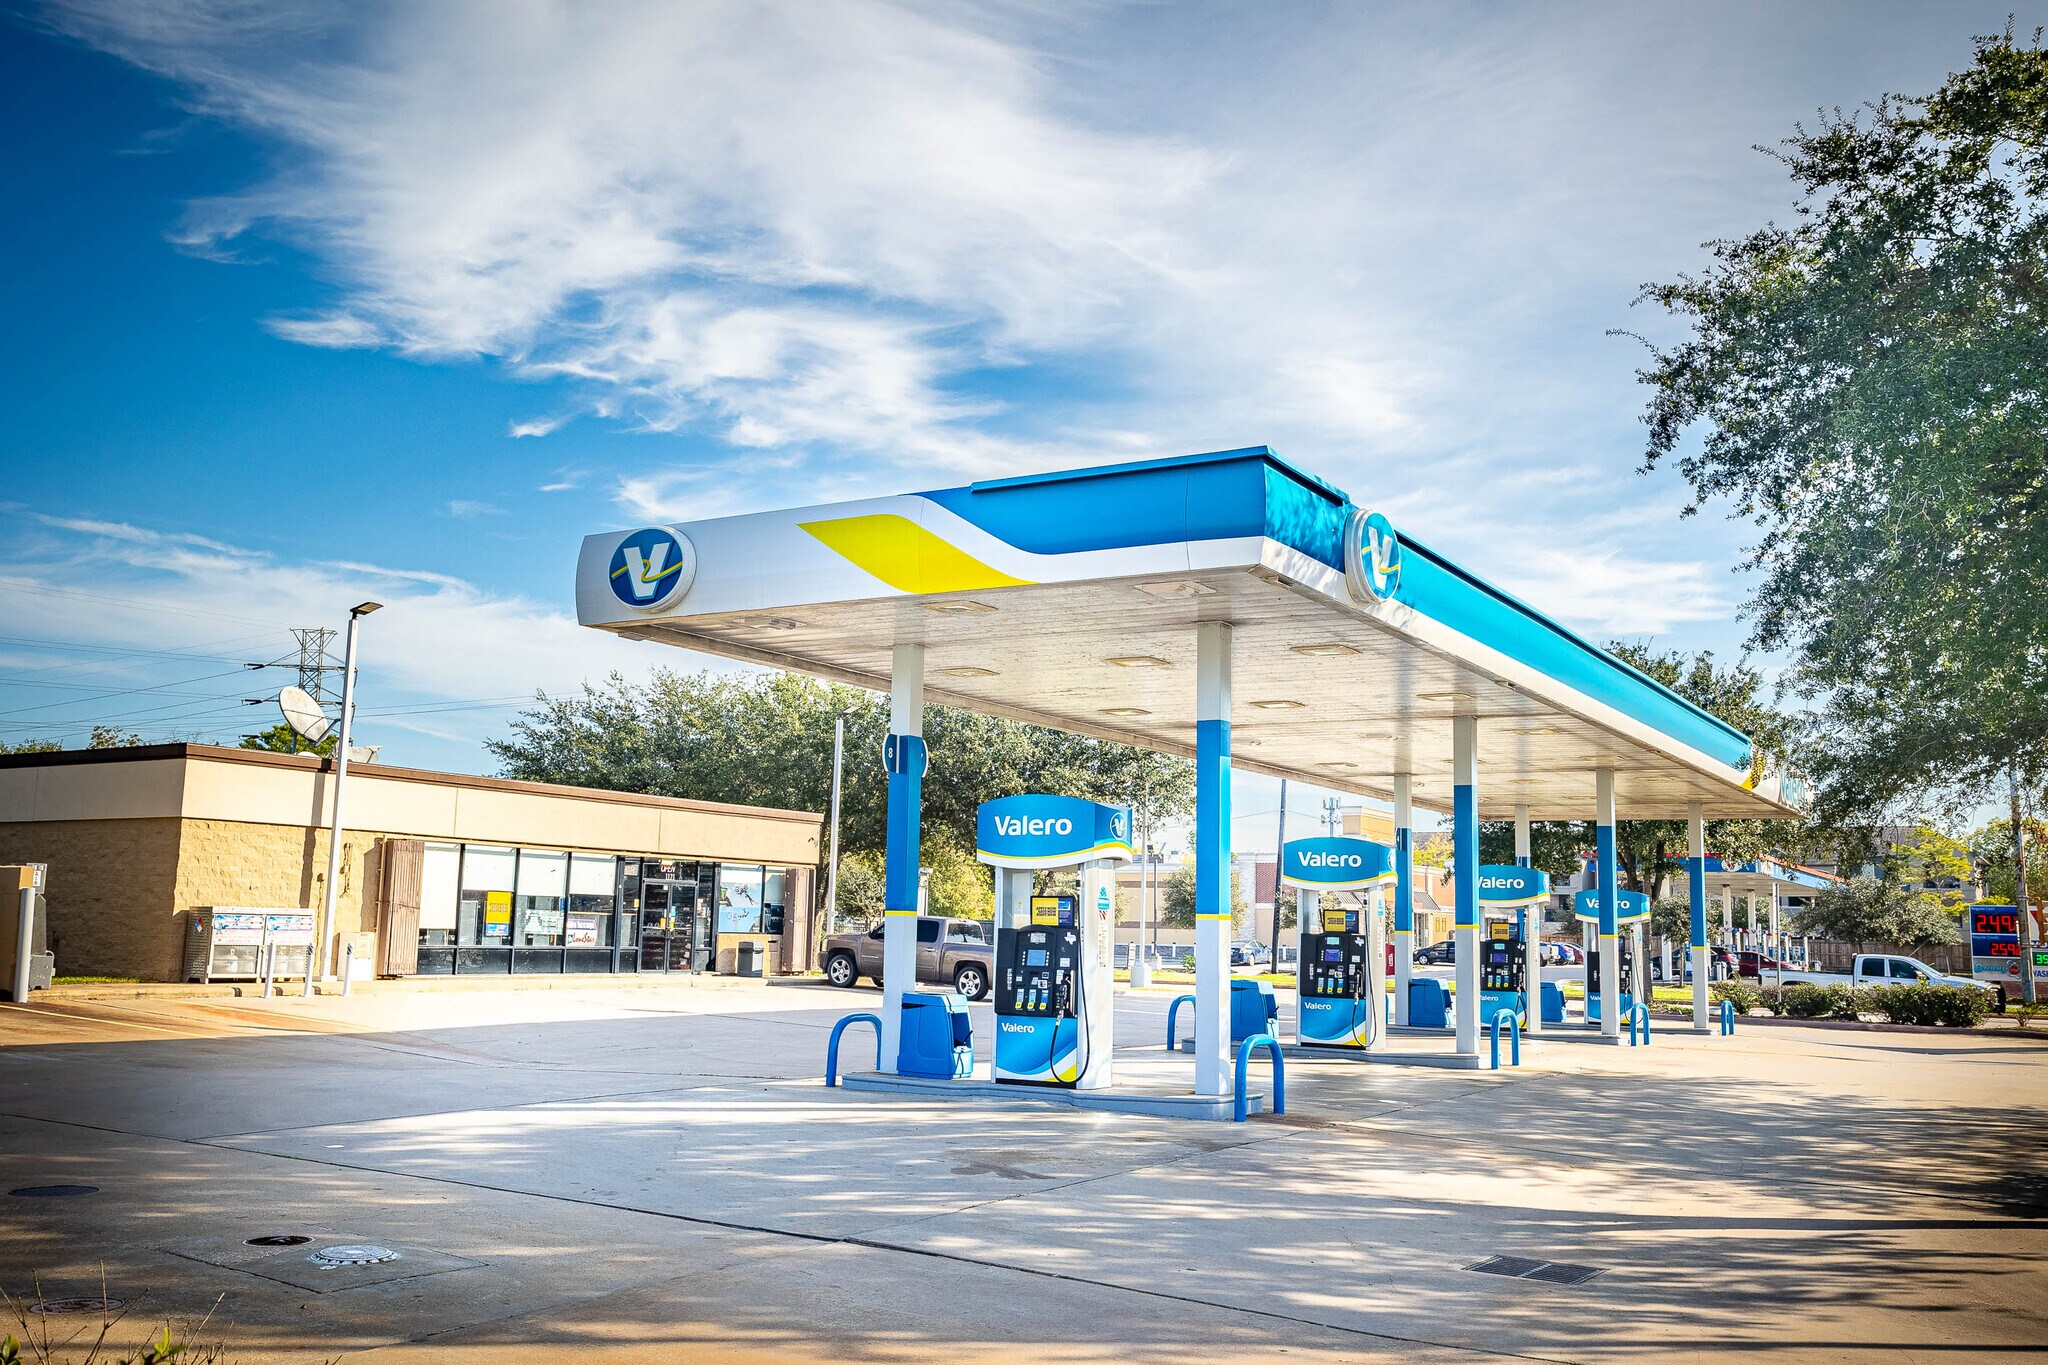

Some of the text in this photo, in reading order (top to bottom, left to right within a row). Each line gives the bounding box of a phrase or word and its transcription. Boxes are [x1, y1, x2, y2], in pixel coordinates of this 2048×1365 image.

[994, 815, 1073, 836] Valero
[1298, 851, 1362, 868] Valero
[1974, 963, 2007, 974] Bunny
[1304, 1002, 1332, 1010] Valero
[1001, 1022, 1035, 1034] Valero
